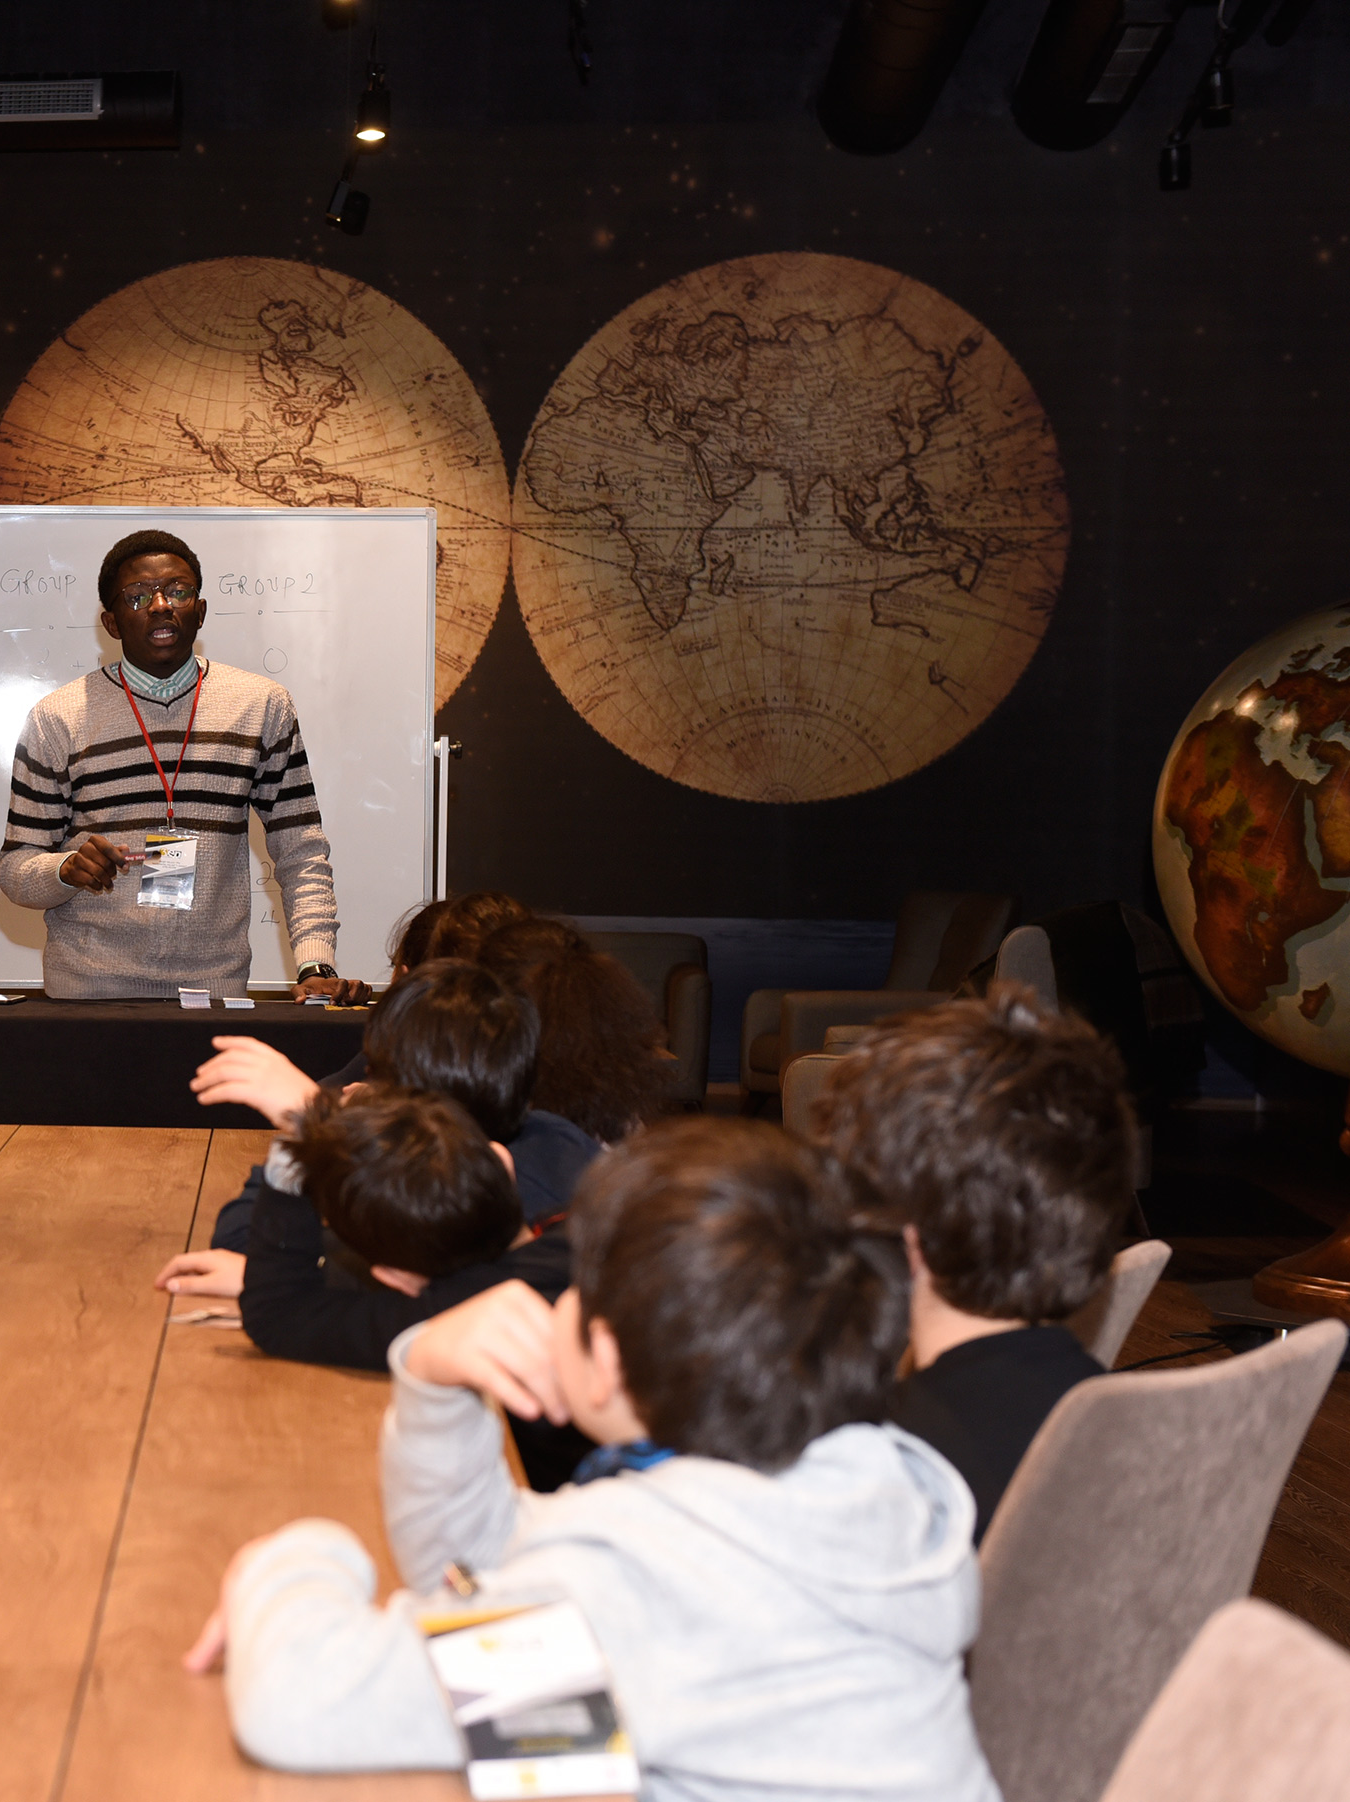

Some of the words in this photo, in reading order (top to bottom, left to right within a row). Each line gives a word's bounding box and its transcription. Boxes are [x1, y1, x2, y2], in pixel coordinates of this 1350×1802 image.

[0, 568, 77, 599] GROUP
[218, 572, 296, 599] GROUP
[300, 572, 319, 595] 2
[260, 909, 281, 928] 4
